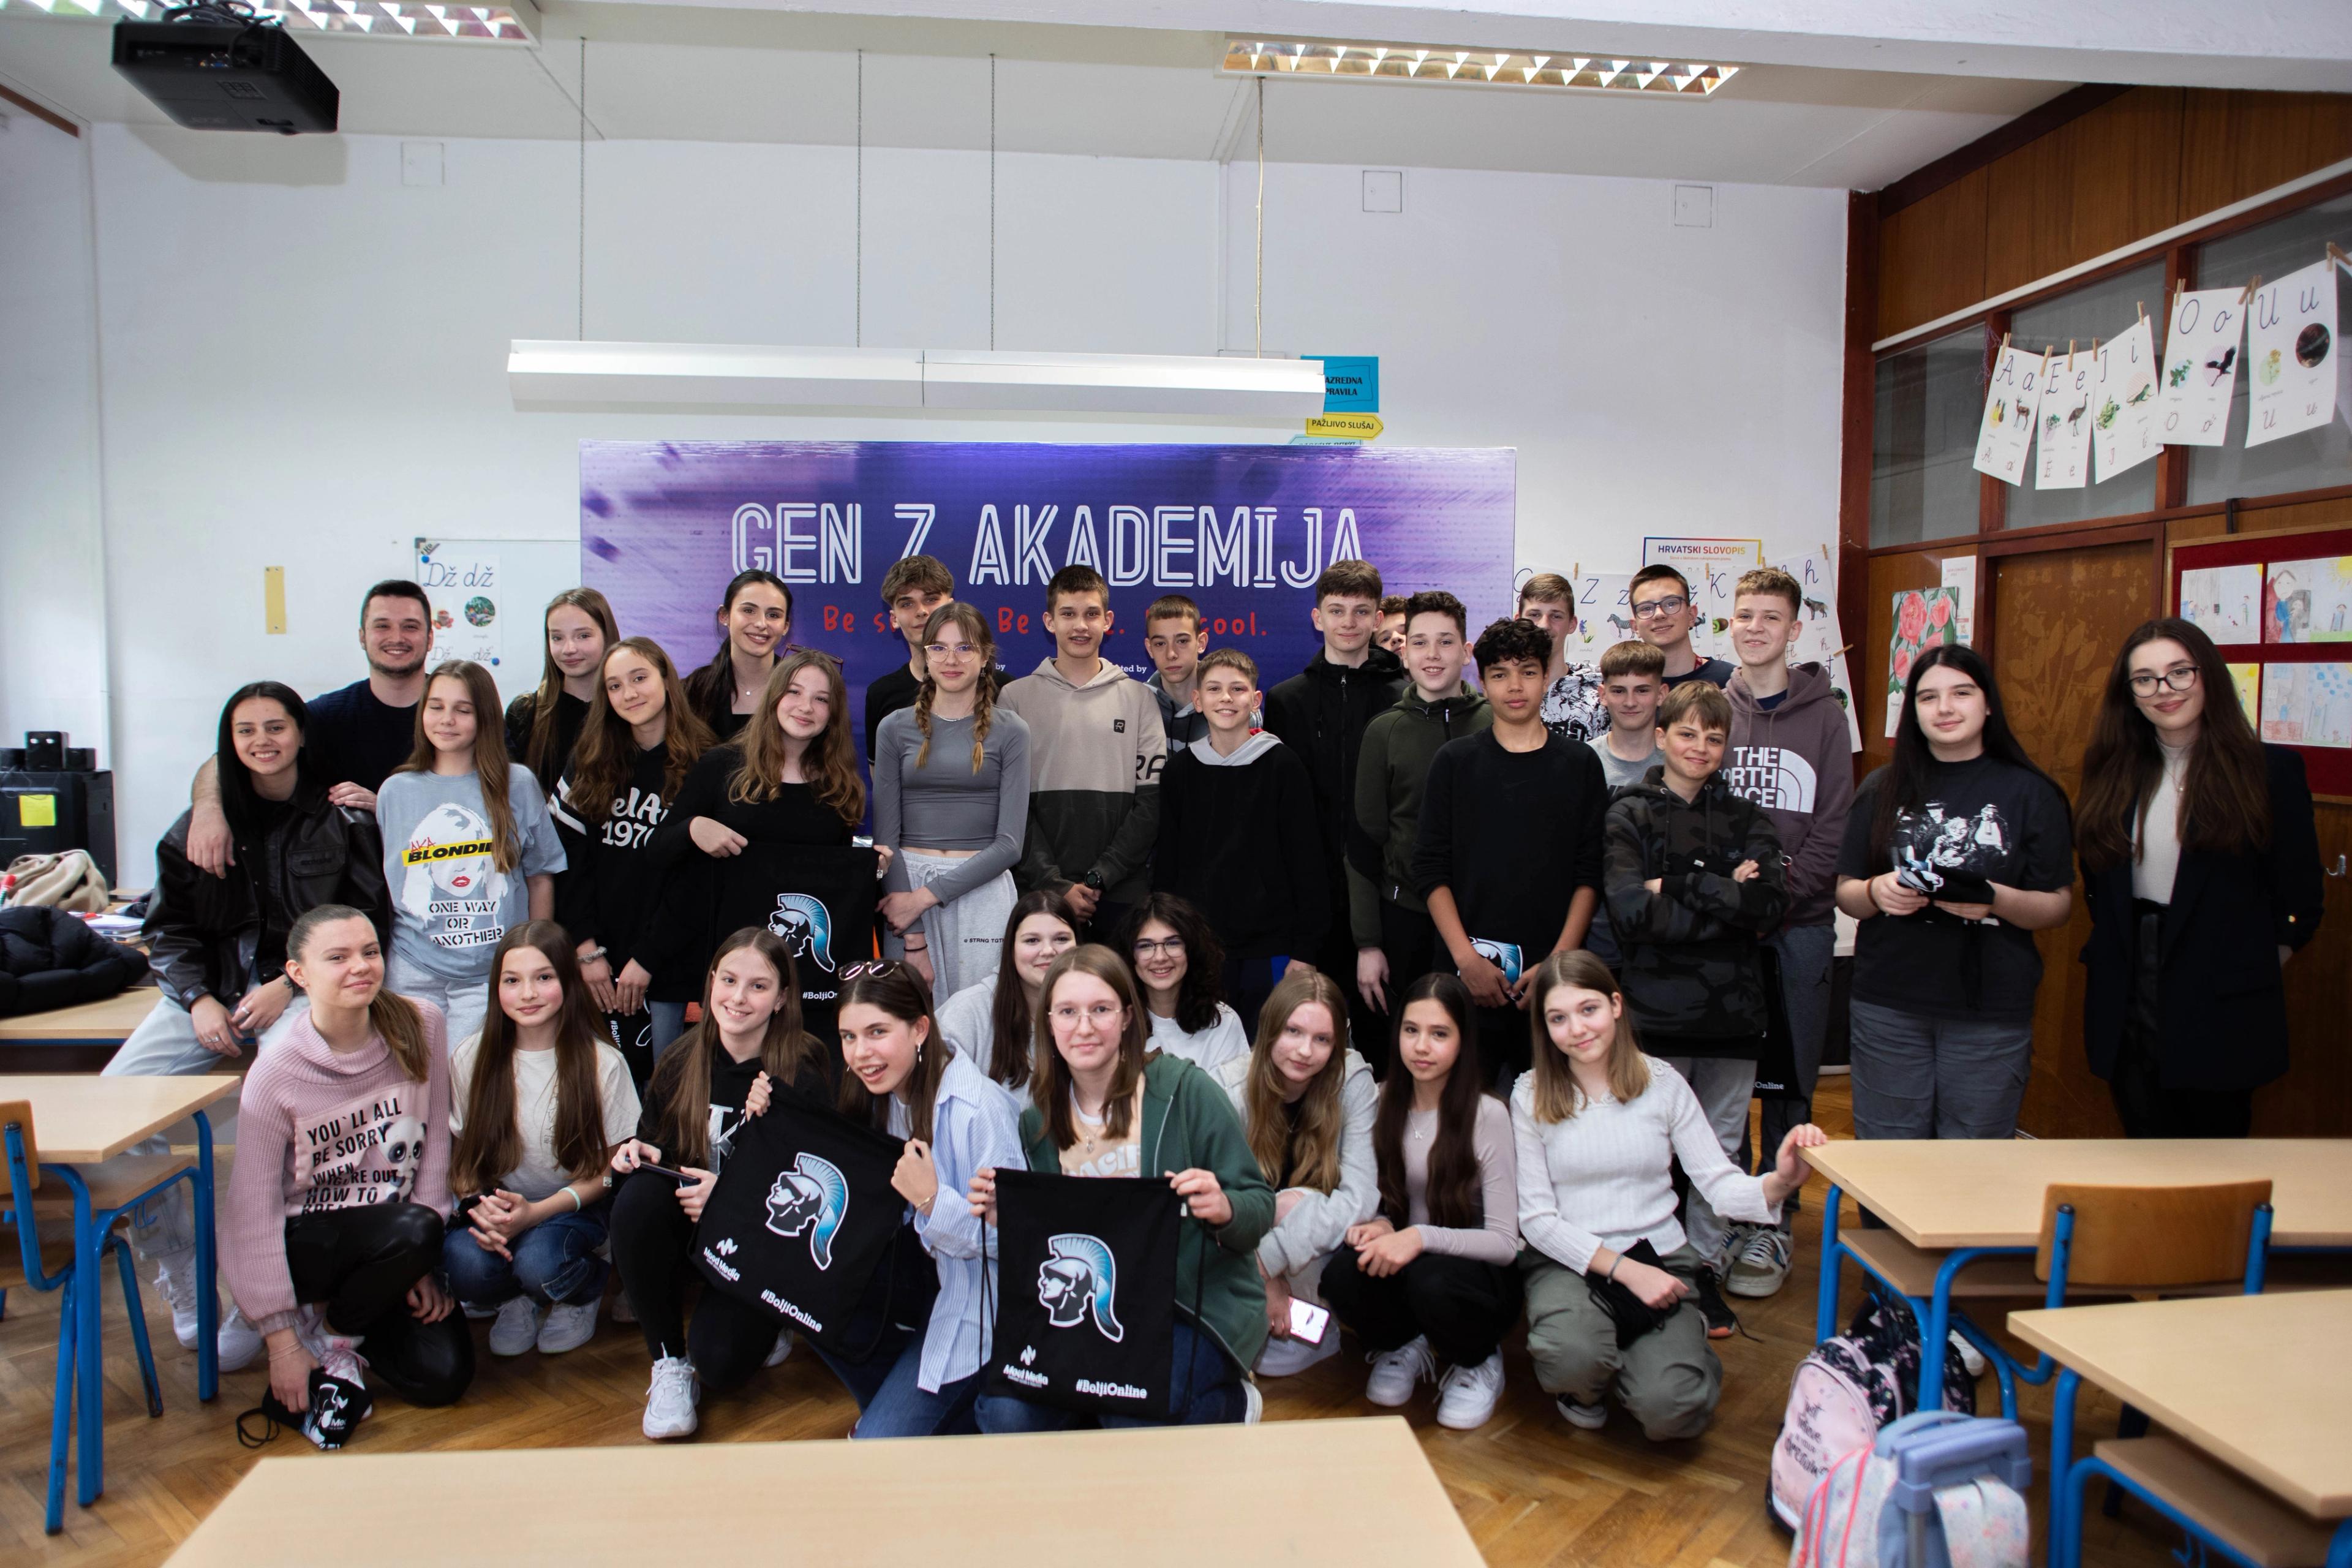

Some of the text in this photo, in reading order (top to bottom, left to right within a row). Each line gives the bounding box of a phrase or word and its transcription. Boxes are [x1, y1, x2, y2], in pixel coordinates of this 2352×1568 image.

[1996, 355, 2035, 391] A a
[2075, 371, 2085, 390] e
[1312, 418, 1374, 430] PAŽLJIVO SLUŠAJ
[732, 503, 862, 584] GEN
[969, 504, 1362, 589] AKADEMIJA
[1658, 545, 1746, 555] HRVATSKI SLOVOPIS
[423, 562, 494, 587] Dž dž
[1580, 579, 1599, 604] Z
[1710, 573, 1726, 598] K
[824, 605, 854, 633] Be
[998, 607, 1029, 635] Be
[995, 662, 1006, 671] by
[1137, 665, 1147, 673] by
[1733, 747, 1779, 767] THE
[1722, 767, 1777, 788] ORTH
[411, 837, 436, 853] AKA
[429, 901, 497, 913] ONE WAY
[447, 918, 469, 929] OR
[432, 928, 503, 946] ANOTHER
[1754, 1081, 1784, 1090] Online
[373, 1098, 402, 1120] ALL
[312, 1125, 388, 1167] BE SORRY
[373, 1169, 398, 1183] OUT
[306, 1186, 378, 1204] HOW TO
[761, 1289, 822, 1332] #BoljiOnline
[1076, 1379, 1147, 1399] #BoljiOnline
